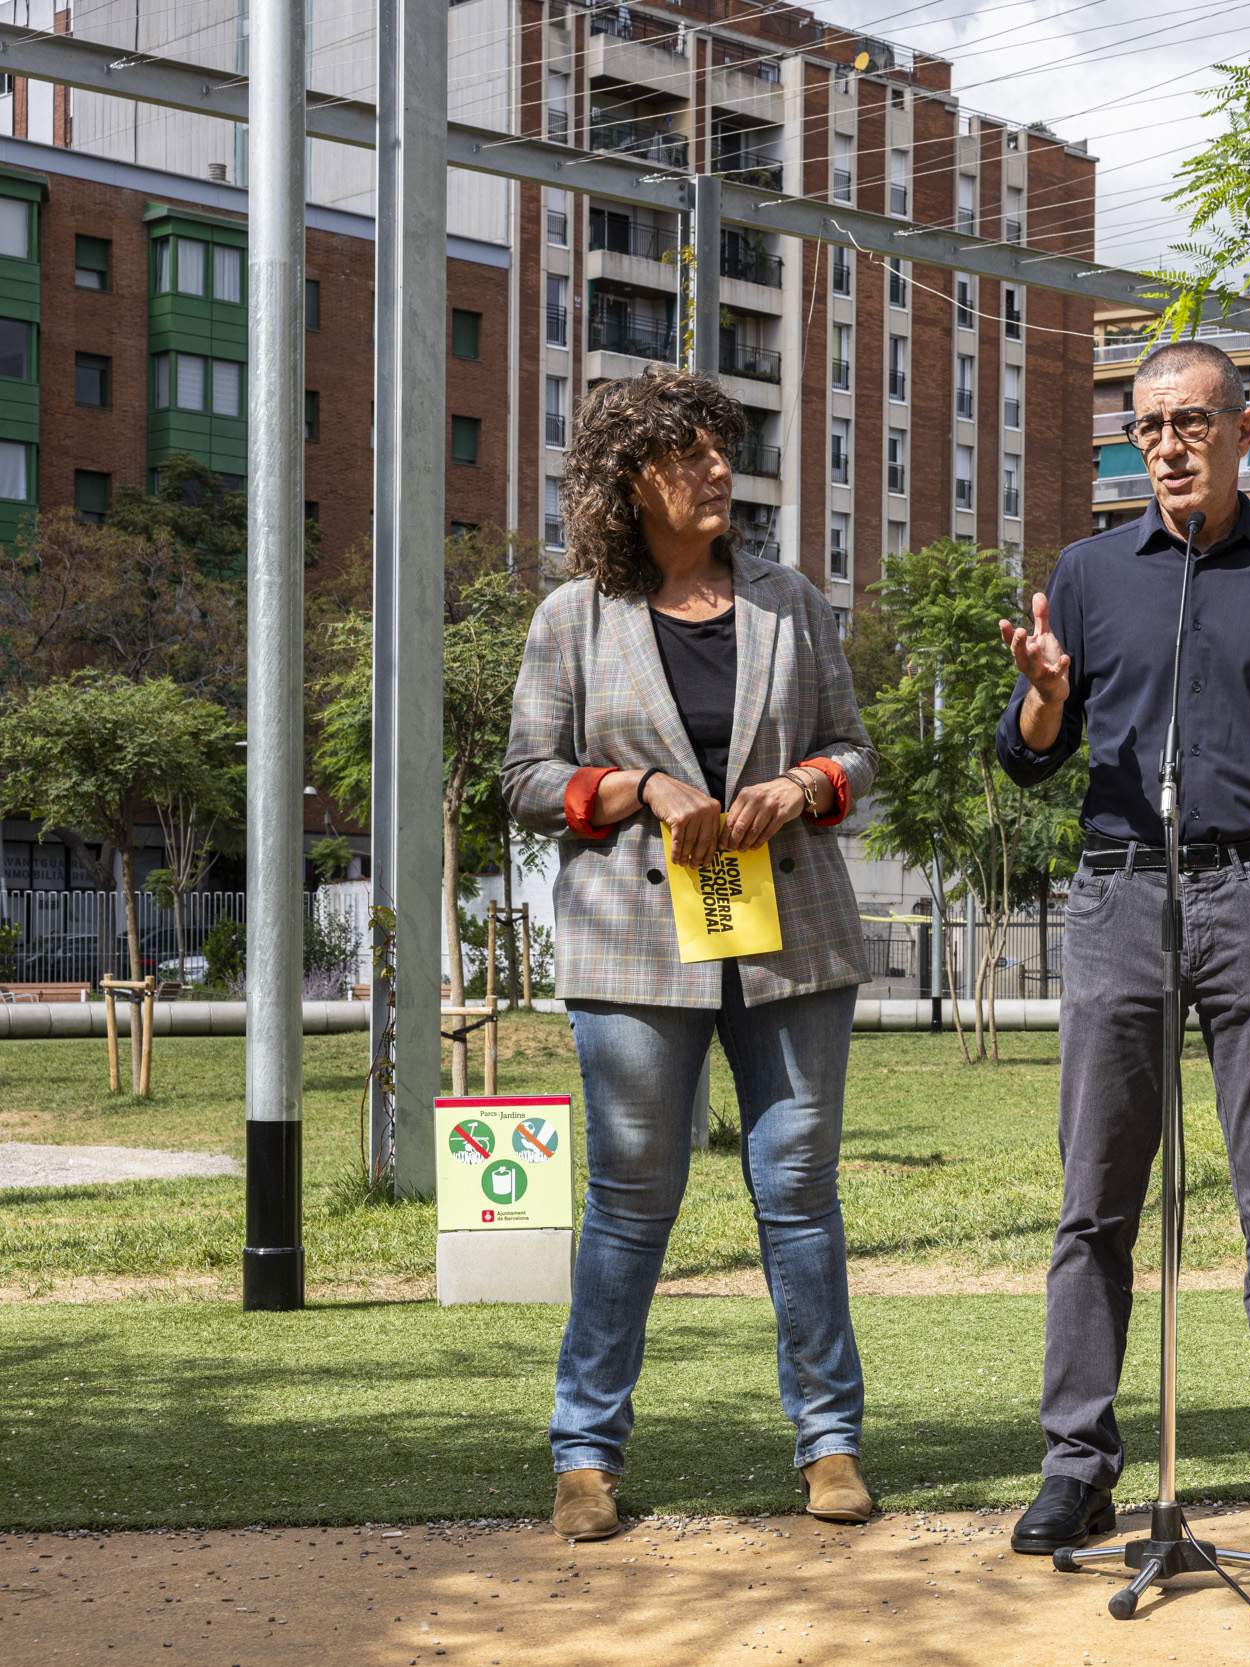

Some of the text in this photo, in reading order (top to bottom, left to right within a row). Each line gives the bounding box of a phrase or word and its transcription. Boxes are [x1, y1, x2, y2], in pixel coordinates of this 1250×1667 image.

[725, 857, 743, 897] NOVA
[698, 863, 721, 935] NACIONAL
[500, 1111, 526, 1120] Jardins
